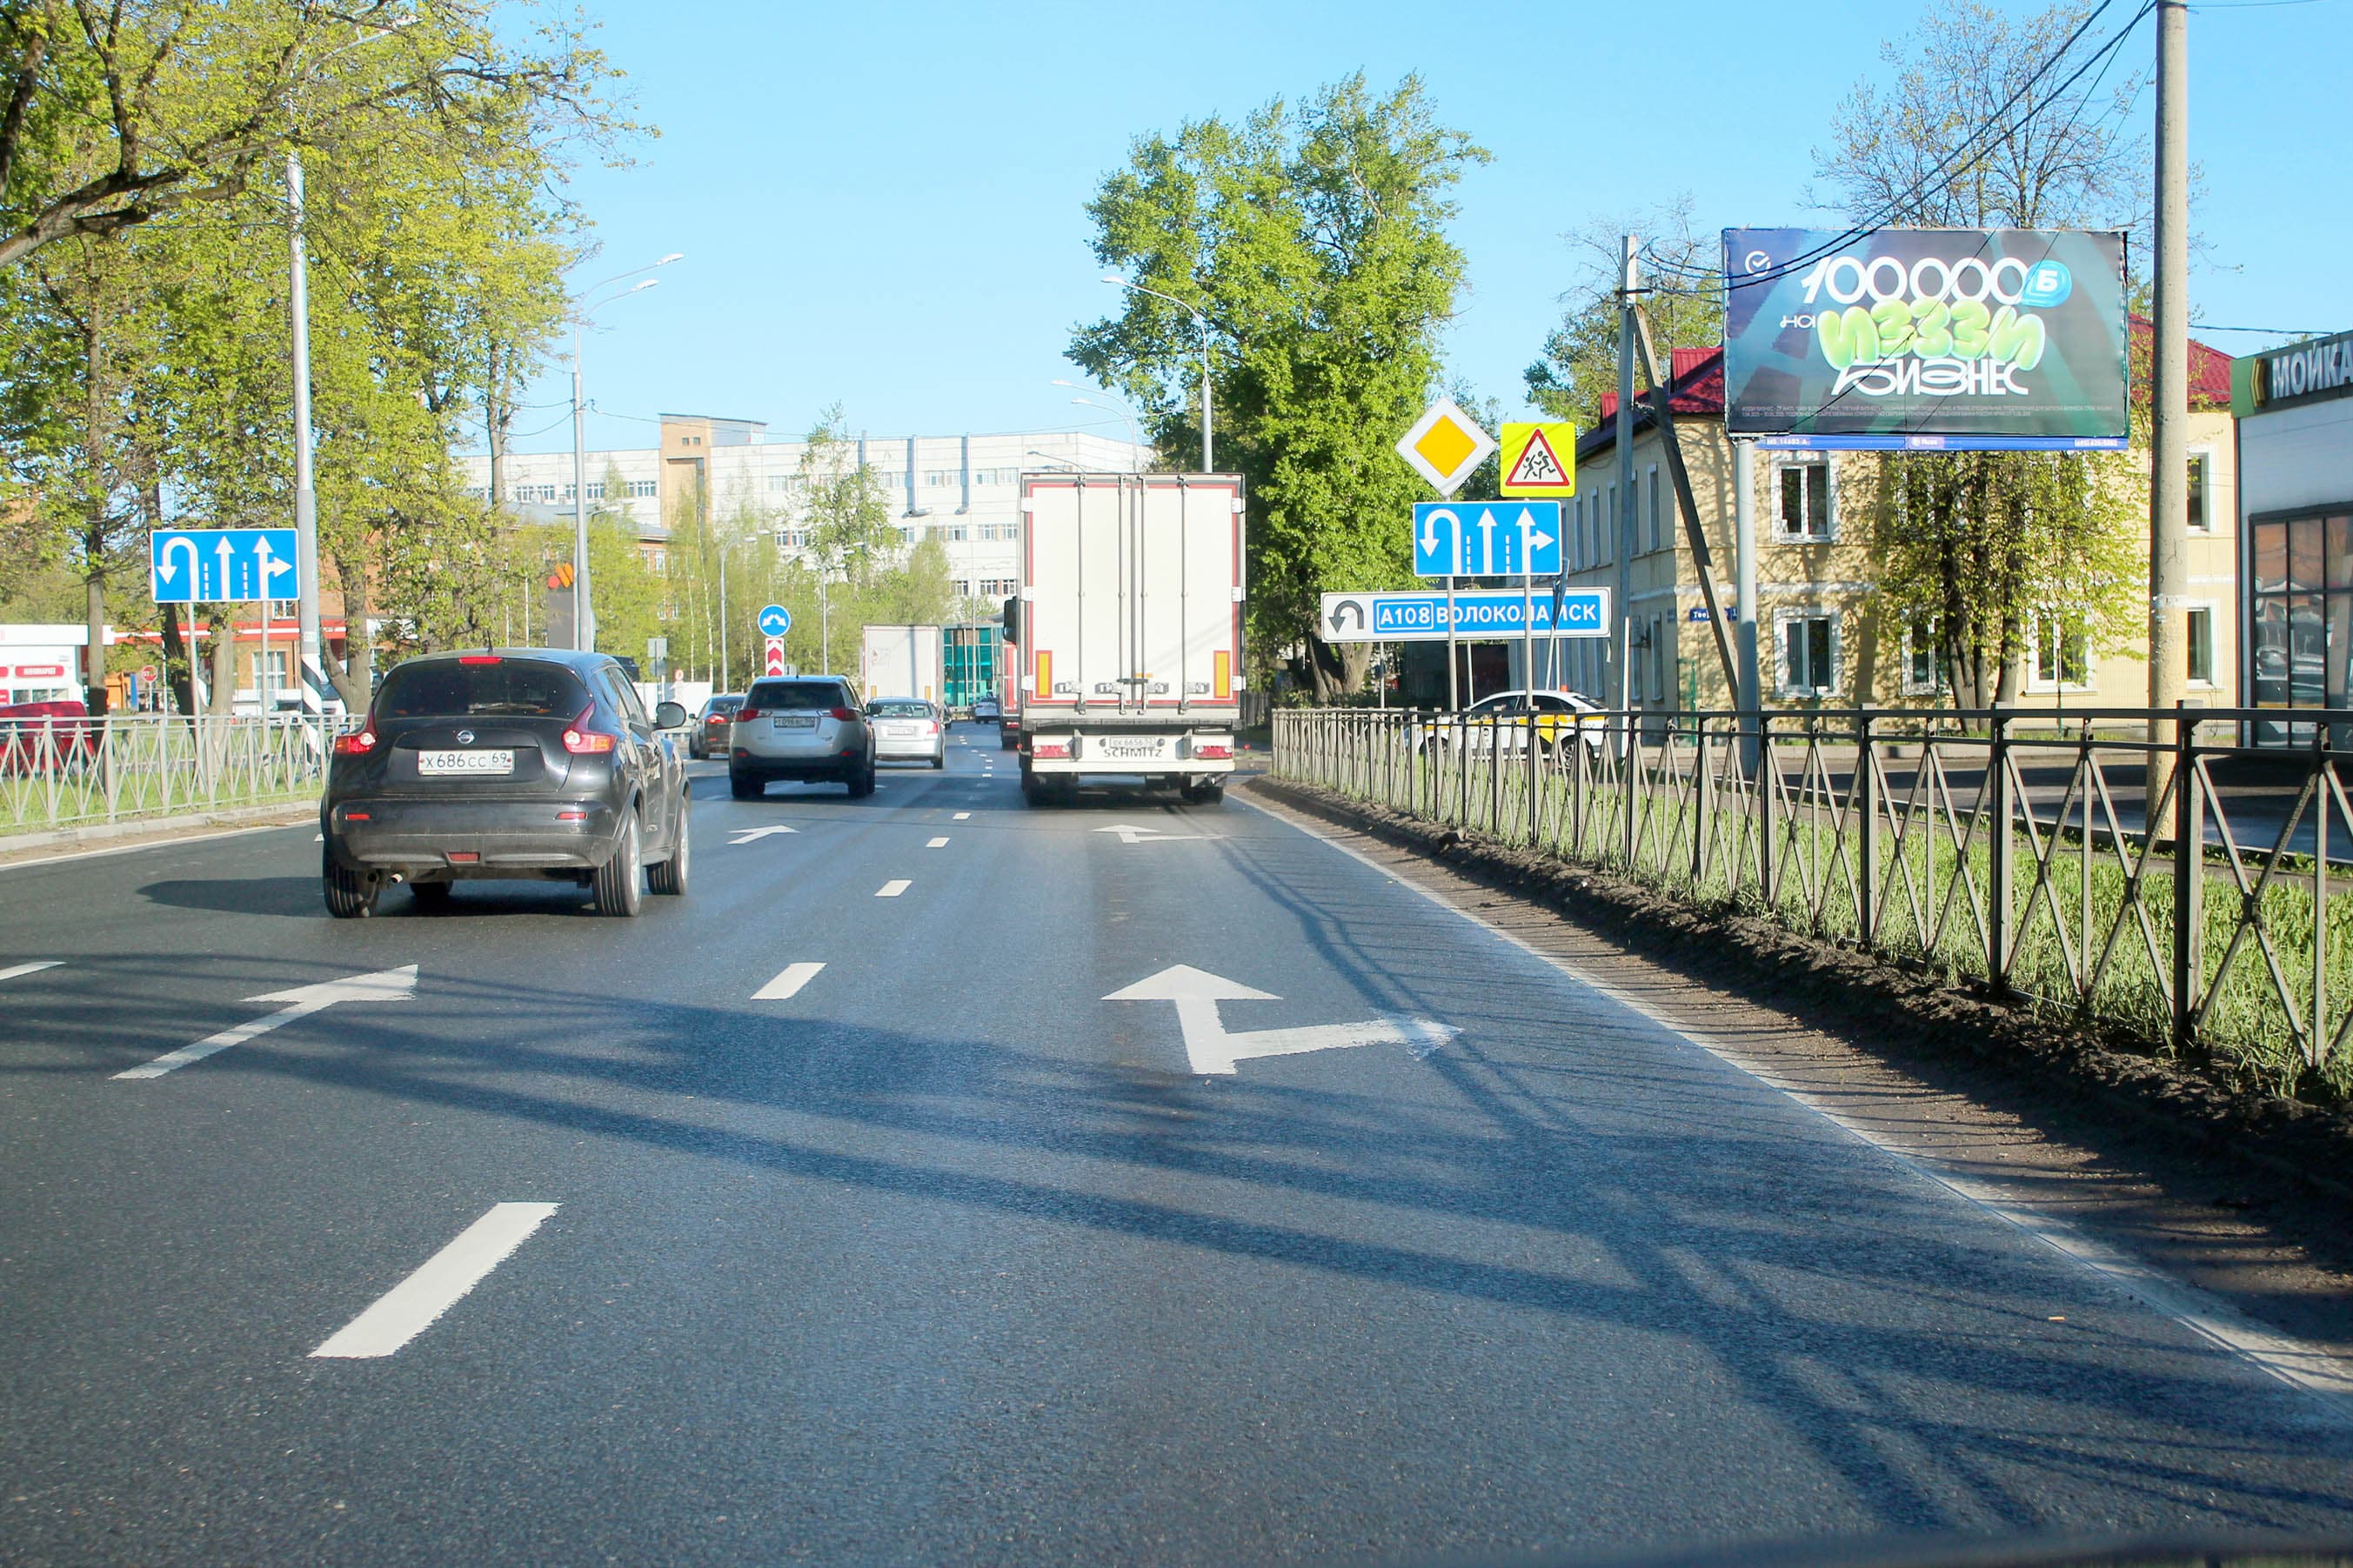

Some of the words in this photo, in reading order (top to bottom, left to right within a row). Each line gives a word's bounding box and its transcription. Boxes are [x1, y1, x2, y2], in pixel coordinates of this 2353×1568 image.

[1830, 357, 2029, 396] БИЗНЕС
[2272, 340, 2353, 399] МОЙКА
[1380, 606, 1431, 624] А108
[1104, 747, 1162, 758] SCHMITZ
